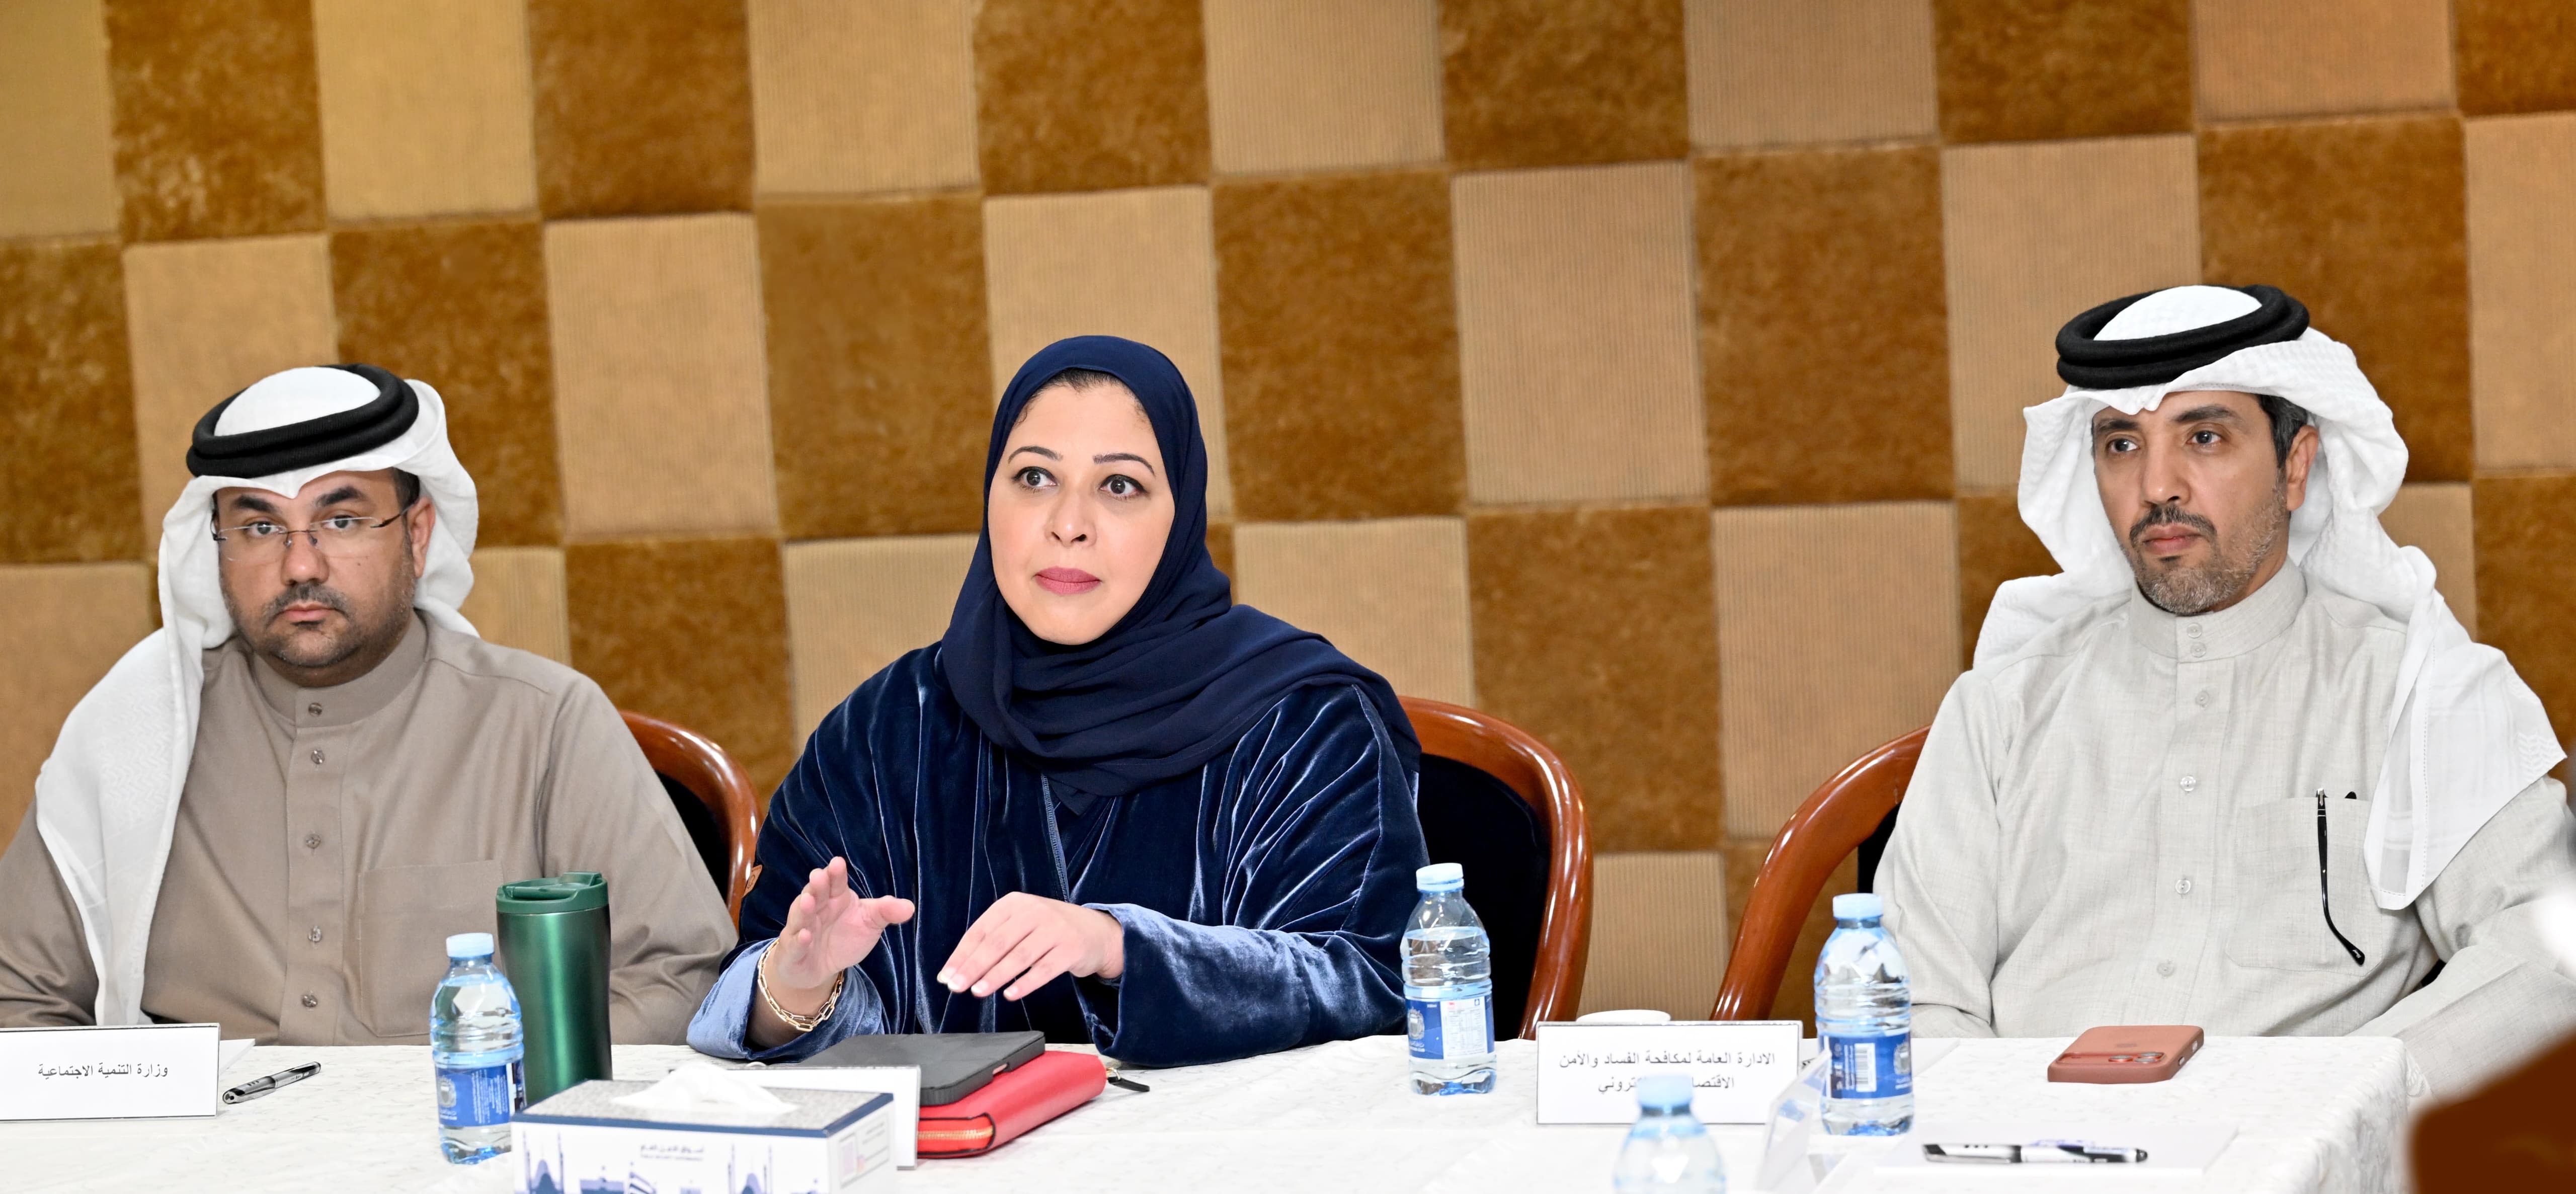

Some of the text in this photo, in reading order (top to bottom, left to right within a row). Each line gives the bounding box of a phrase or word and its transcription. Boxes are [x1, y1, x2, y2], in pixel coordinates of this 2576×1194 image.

[1604, 1052, 1639, 1065] الفساد
[1645, 1050, 1691, 1065] لمكافحة
[1696, 1050, 1731, 1064] العامة
[1737, 1052, 1775, 1068] الادارة
[38, 1062, 168, 1080] وزارة التنمية الاجتماعية
[1692, 1074, 1734, 1089] الاقتصا
